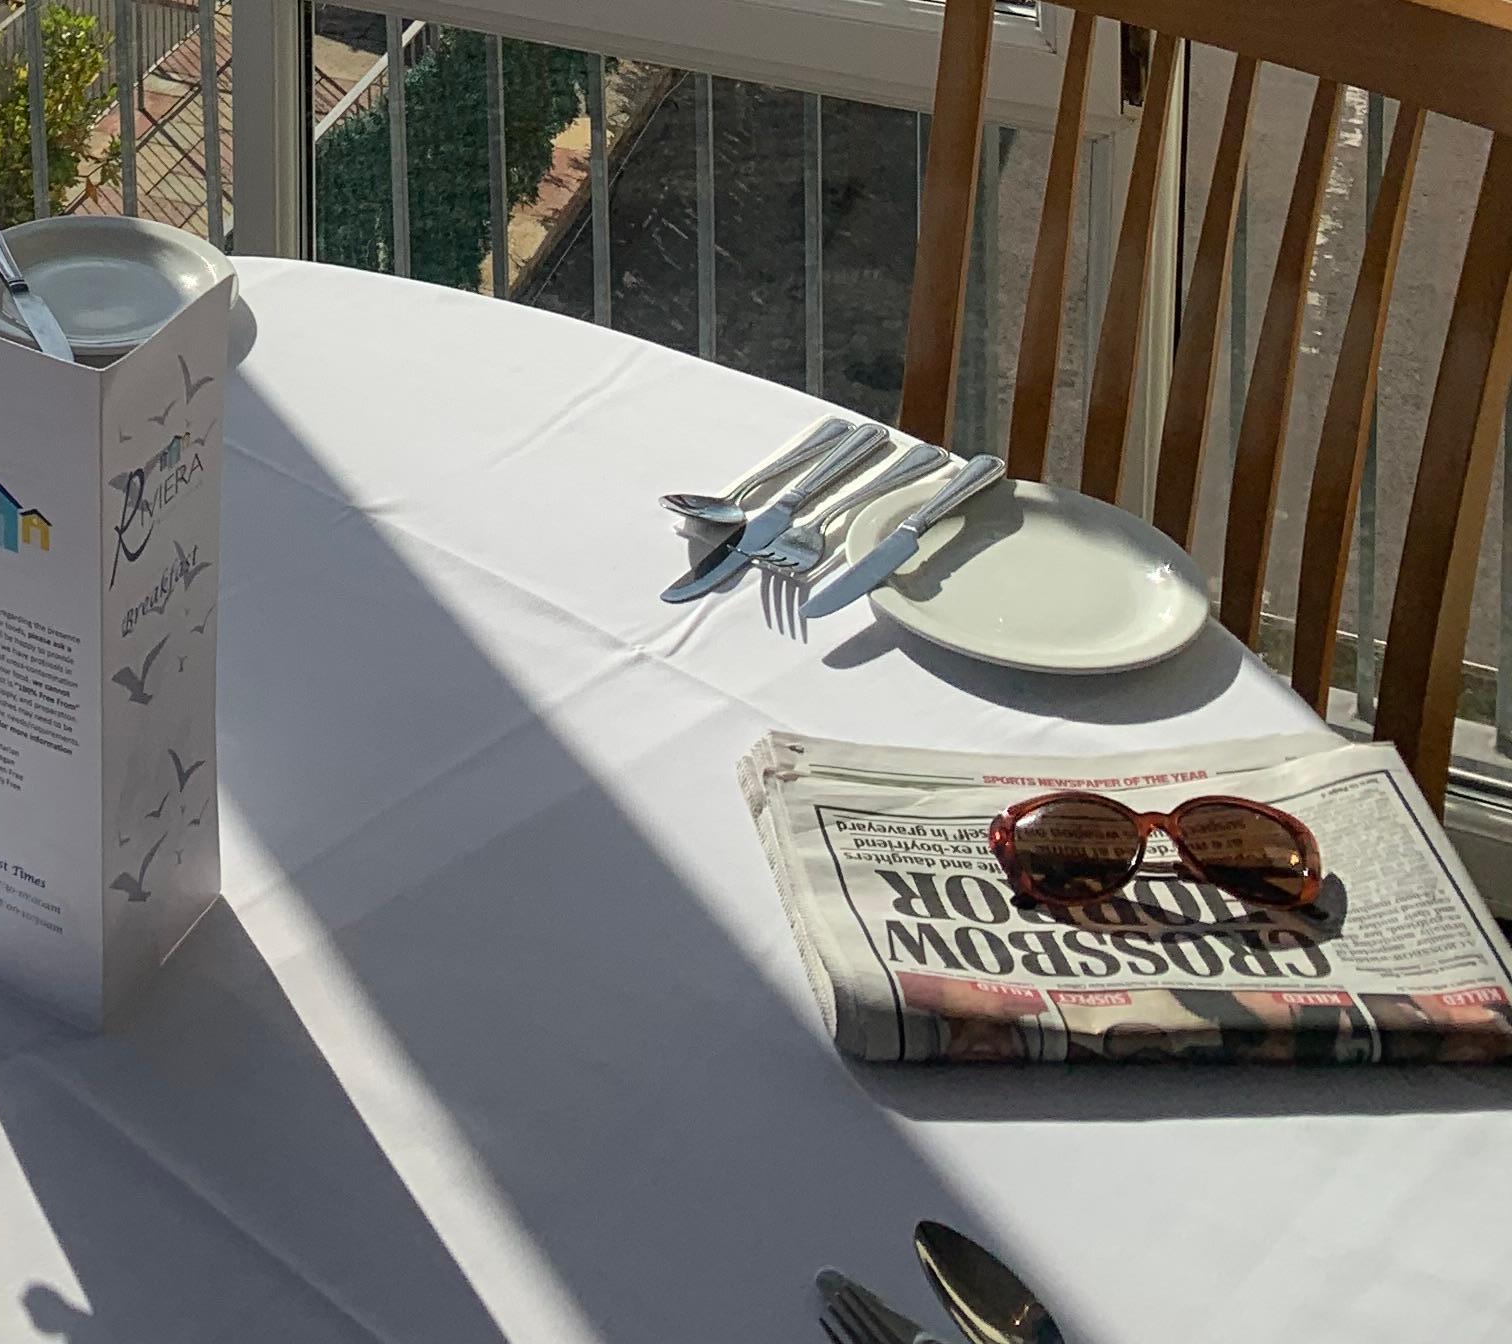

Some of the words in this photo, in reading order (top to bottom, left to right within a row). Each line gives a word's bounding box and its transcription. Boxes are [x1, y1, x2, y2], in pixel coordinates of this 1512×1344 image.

[109, 453, 203, 591] RIVIERA
[121, 544, 199, 638] Breakfast
[28, 632, 51, 646] please
[53, 641, 65, 650] ask
[32, 622, 46, 633] the
[47, 628, 81, 644] presence
[1, 645, 11, 653] we
[12, 647, 29, 661] have
[30, 656, 64, 673] protocols
[14, 637, 36, 653] happy
[47, 650, 74, 665] provide
[7, 658, 78, 688] cross-contamination
[32, 680, 43, 688] we
[45, 684, 70, 698] cannot
[19, 697, 33, 707] and
[39, 692, 55, 704] Free
[18, 707, 33, 718] may
[32, 712, 52, 726] need
[10, 726, 28, 738] more
[30, 734, 72, 755] information
[9, 768, 24, 782] Free
[983, 775, 1036, 786] SPORTS
[1038, 776, 1121, 788] NEWSPAPER
[1123, 776, 1141, 787] OF
[1143, 773, 1169, 785] THE
[1170, 770, 1208, 783] YEAR
[6, 778, 21, 791] Free
[835, 821, 927, 836] graveyard
[930, 829, 946, 841] in
[853, 838, 972, 855] ex-boyfriend
[843, 852, 936, 868] daughters
[939, 859, 973, 870] and
[978, 861, 1001, 874] ife
[12, 865, 46, 888] Times
[886, 920, 1332, 978] CROSSBOW
[1059, 993, 1127, 1005] SUSPECT
[1282, 994, 1341, 1005] KILLED
[1442, 988, 1501, 1005] KILLED
